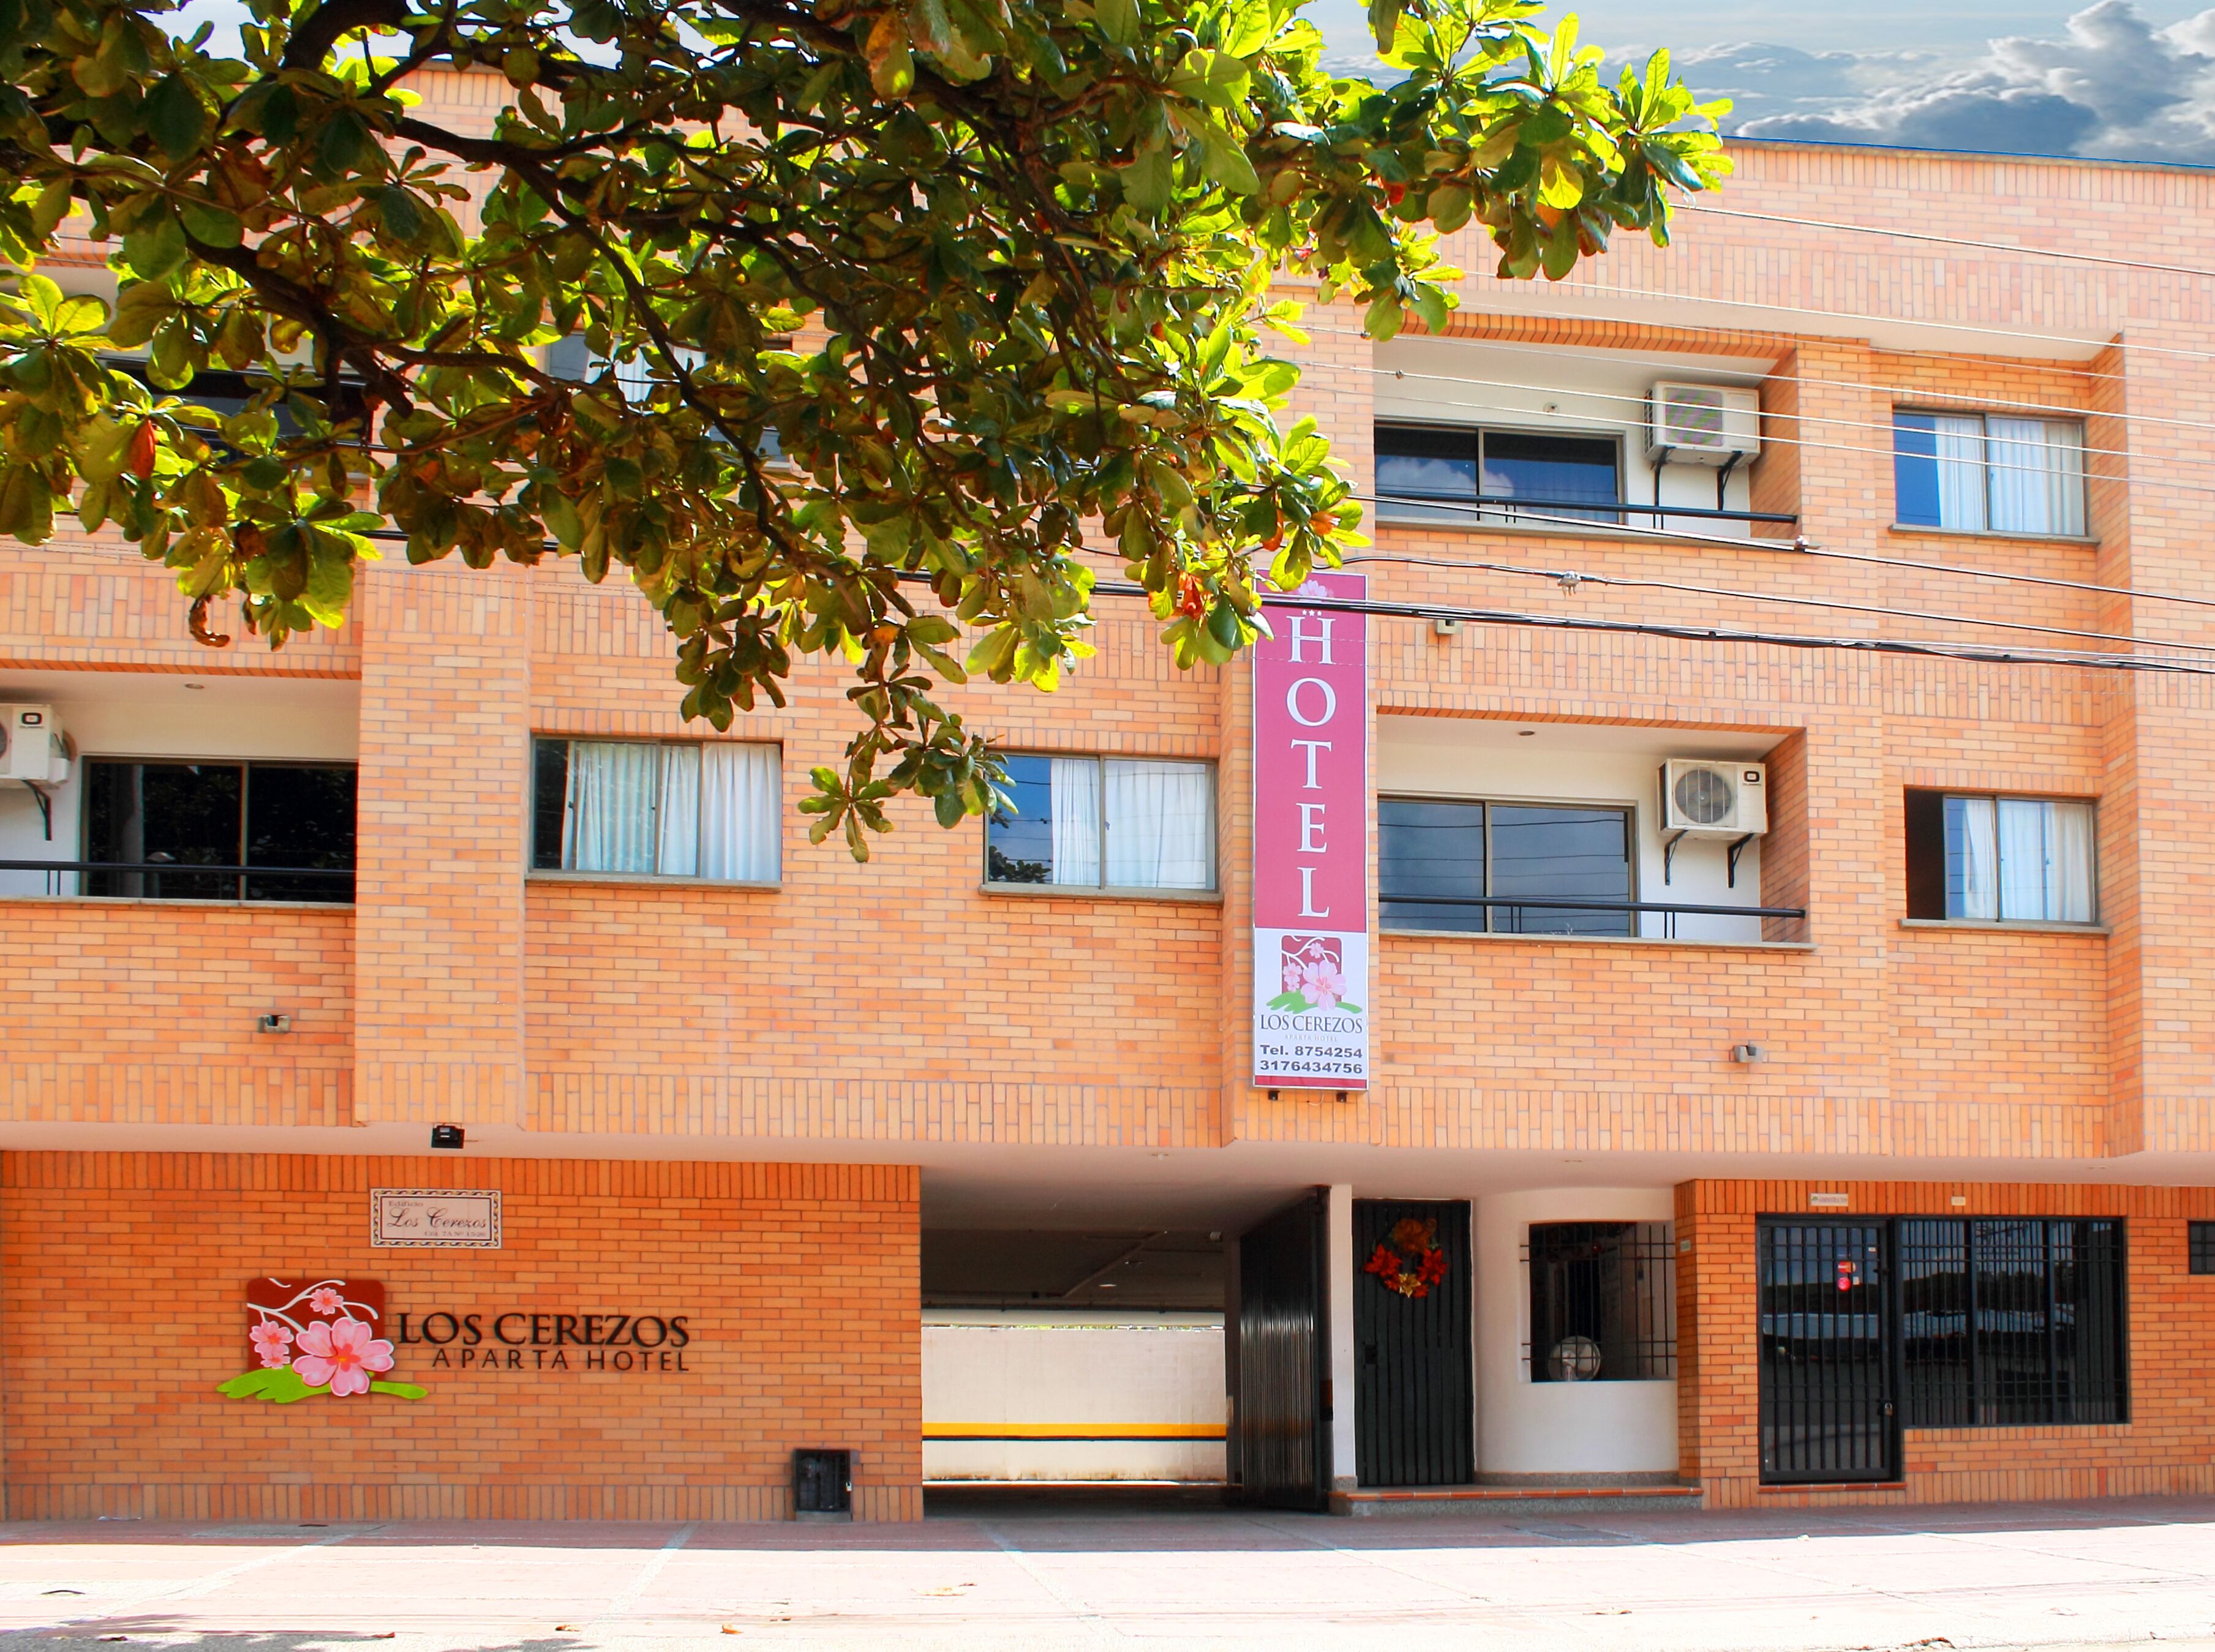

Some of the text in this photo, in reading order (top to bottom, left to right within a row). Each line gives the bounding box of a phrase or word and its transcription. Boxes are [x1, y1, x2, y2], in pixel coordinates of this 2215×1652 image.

[1286, 615, 1336, 918] HOTEL
[1260, 1014, 1363, 1034] LOS CEREZOS
[1260, 1044, 1363, 1058] Tel. 8754254
[1260, 1060, 1363, 1073] 3176434756
[386, 1206, 487, 1228] Los Cerezos
[397, 1312, 690, 1348] LOS CEREZOS
[432, 1348, 690, 1372] APARTA HOTEL
